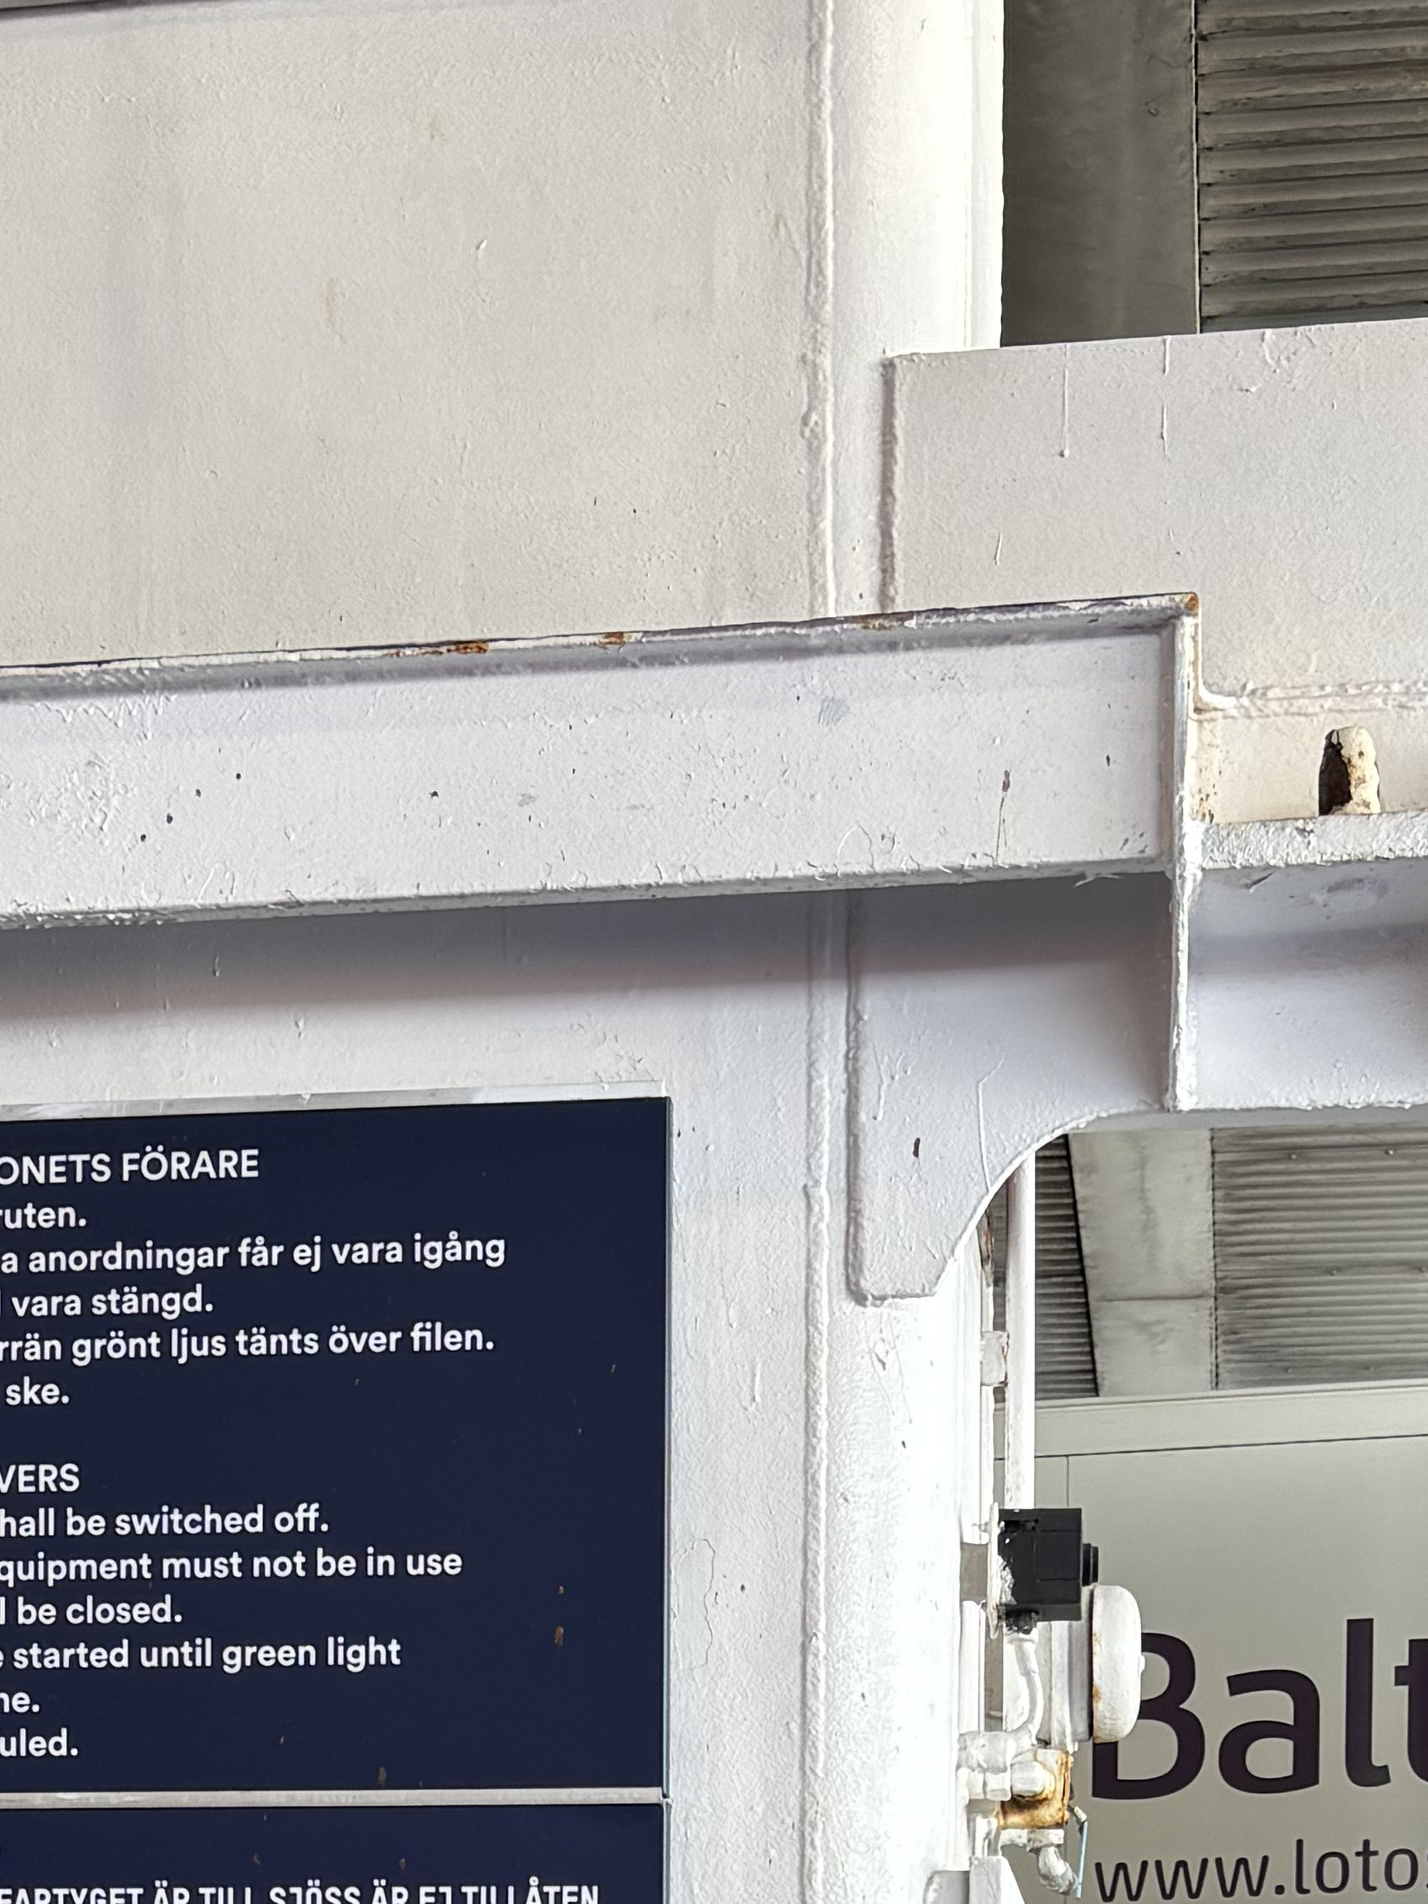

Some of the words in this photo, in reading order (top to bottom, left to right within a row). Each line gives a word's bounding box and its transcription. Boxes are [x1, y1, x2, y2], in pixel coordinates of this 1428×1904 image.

[122, 1144, 259, 1182] FÖRARE
[28, 1239, 230, 1276] anordningar
[237, 1235, 285, 1267] får
[292, 1235, 322, 1273] ej
[331, 1241, 403, 1265] vara
[413, 1230, 505, 1270] igång
[11, 1294, 82, 1317] vara
[91, 1283, 214, 1321] stängd.
[71, 1330, 161, 1367] grönt
[171, 1327, 227, 1365] ljus
[235, 1326, 319, 1356] tänts
[328, 1324, 403, 1354] över
[410, 1321, 494, 1352] filen.
[5, 1375, 70, 1406] ske.
[66, 1506, 106, 1536] be
[115, 1503, 264, 1536] switched
[274, 1502, 329, 1533] off.
[162, 1551, 243, 1579] must
[252, 1550, 306, 1578] not
[316, 1547, 357, 1577] be
[366, 1546, 395, 1576] in
[406, 1553, 463, 1576] use
[17, 1595, 57, 1625] be
[65, 1593, 183, 1625] closed.
[13, 1638, 129, 1670] started
[140, 1637, 212, 1668] until
[222, 1644, 316, 1674] green
[327, 1635, 401, 1673] light
